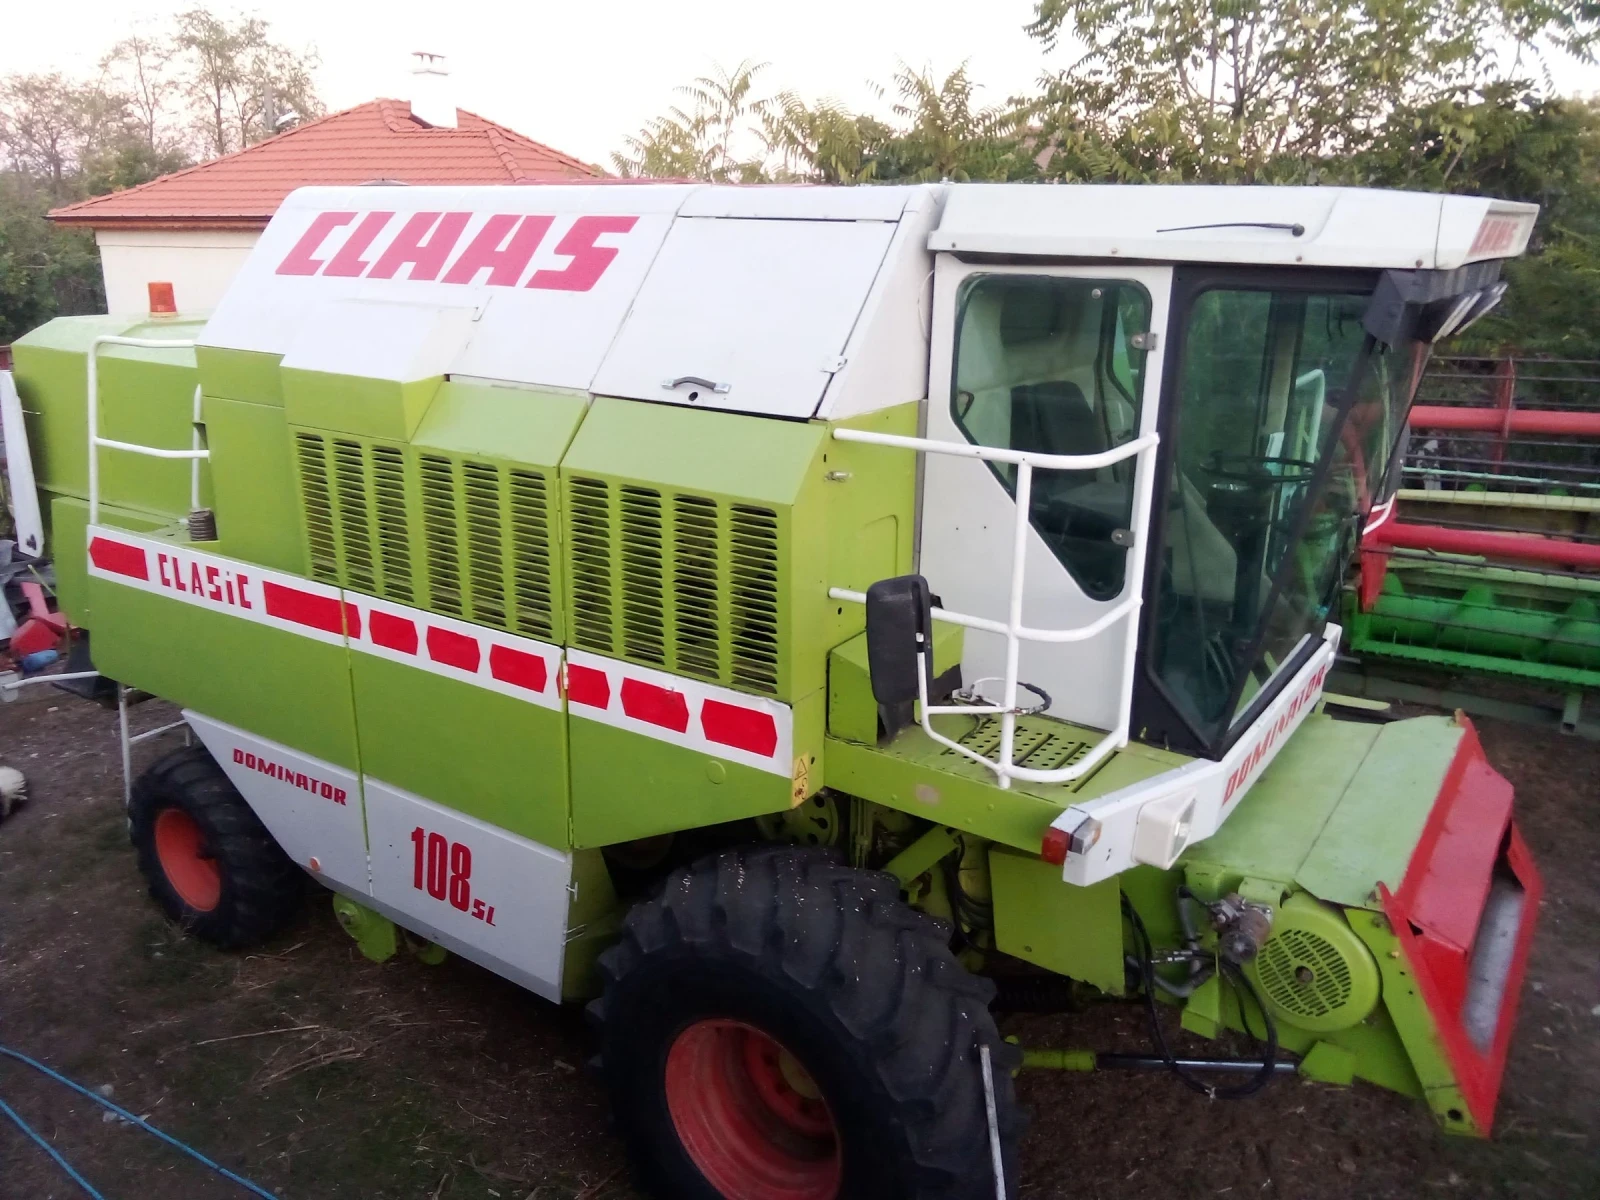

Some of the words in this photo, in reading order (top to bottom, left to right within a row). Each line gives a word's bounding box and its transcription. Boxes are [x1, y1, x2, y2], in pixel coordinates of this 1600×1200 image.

[275, 211, 640, 291] CLAAS
[233, 748, 347, 806] DOMINATOR
[411, 826, 472, 912] 108
[471, 899, 496, 927] SL
